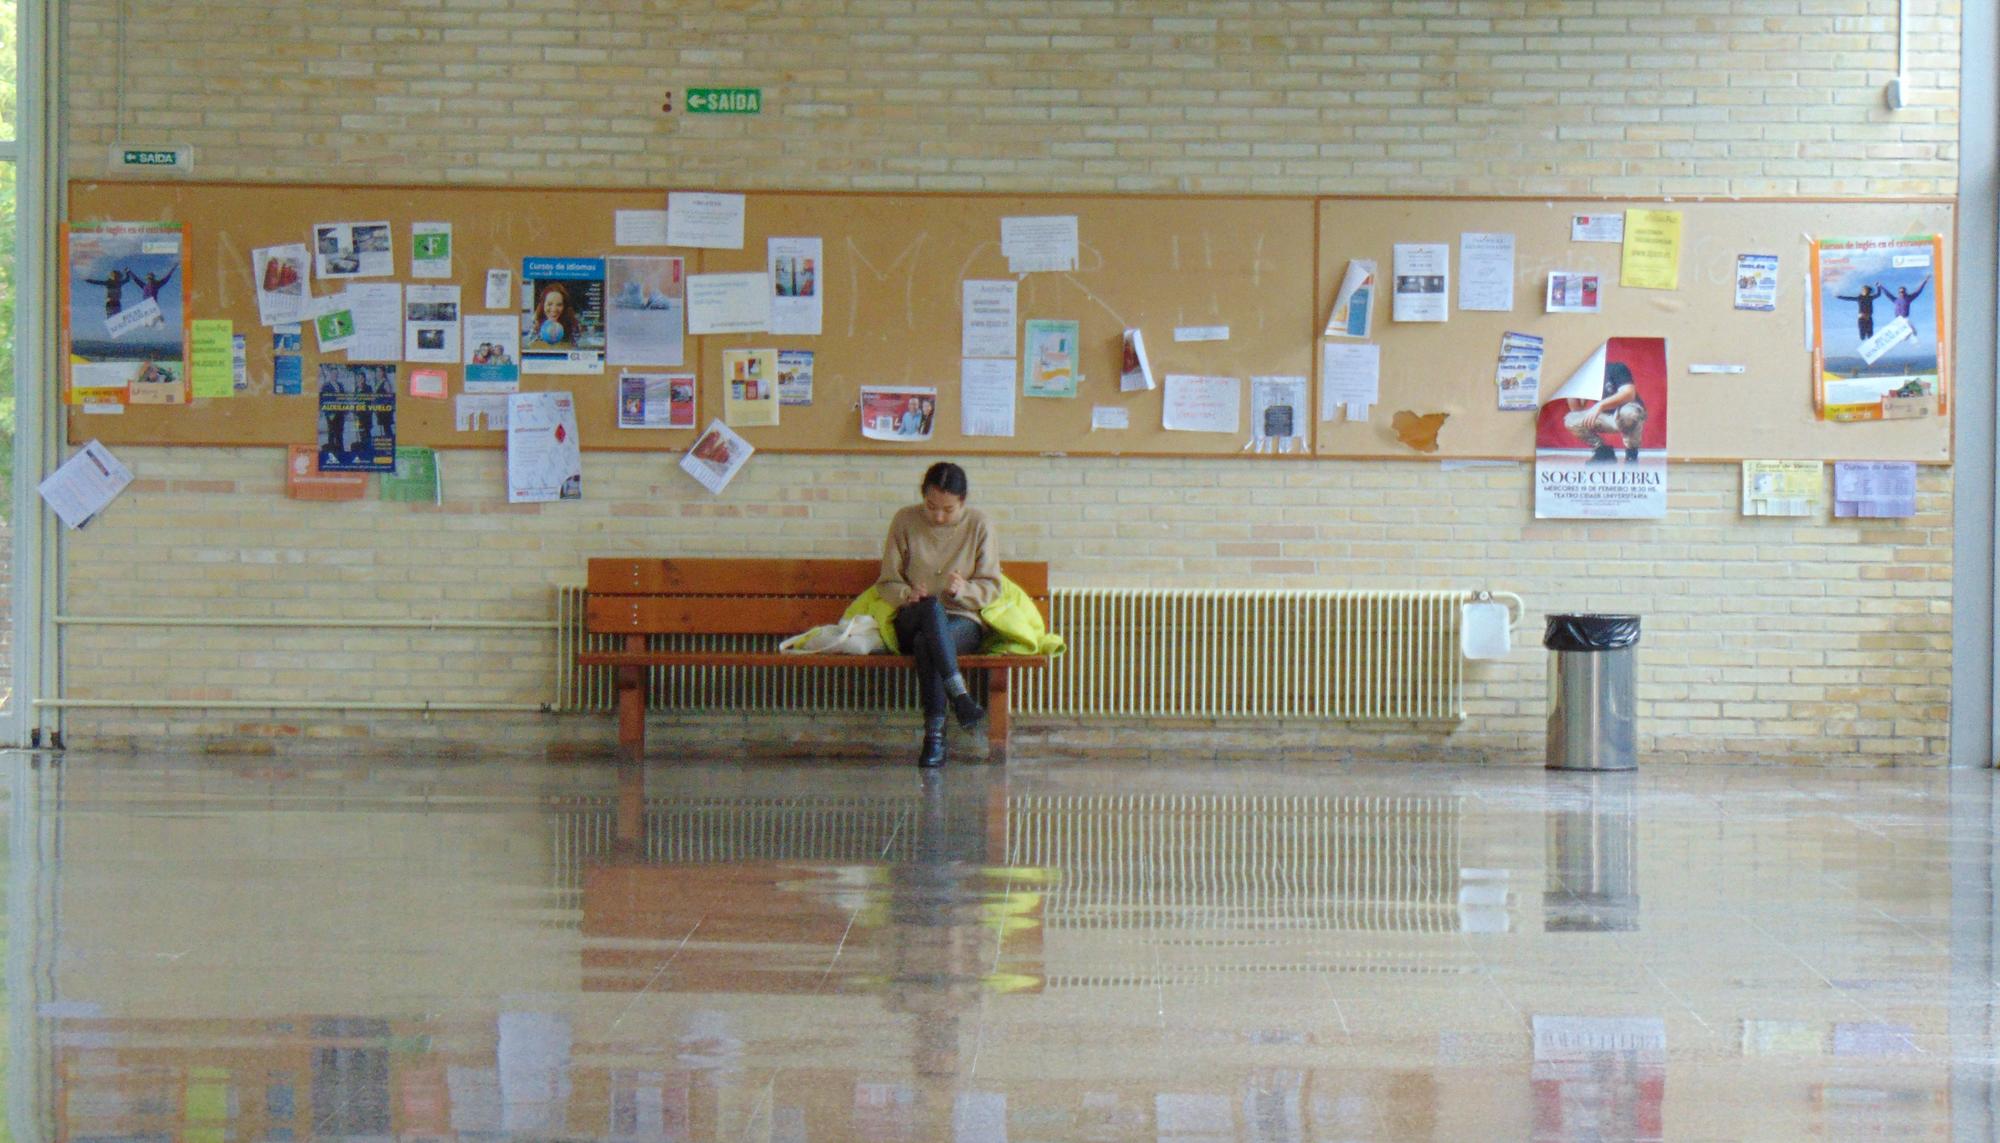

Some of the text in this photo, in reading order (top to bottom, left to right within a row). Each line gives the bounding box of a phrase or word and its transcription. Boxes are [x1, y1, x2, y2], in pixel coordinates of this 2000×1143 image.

[707, 90, 758, 110] SAÍDA
[529, 262, 596, 271] Cursos de idiomas
[1541, 471, 1660, 485] SOGE CULEBRA
